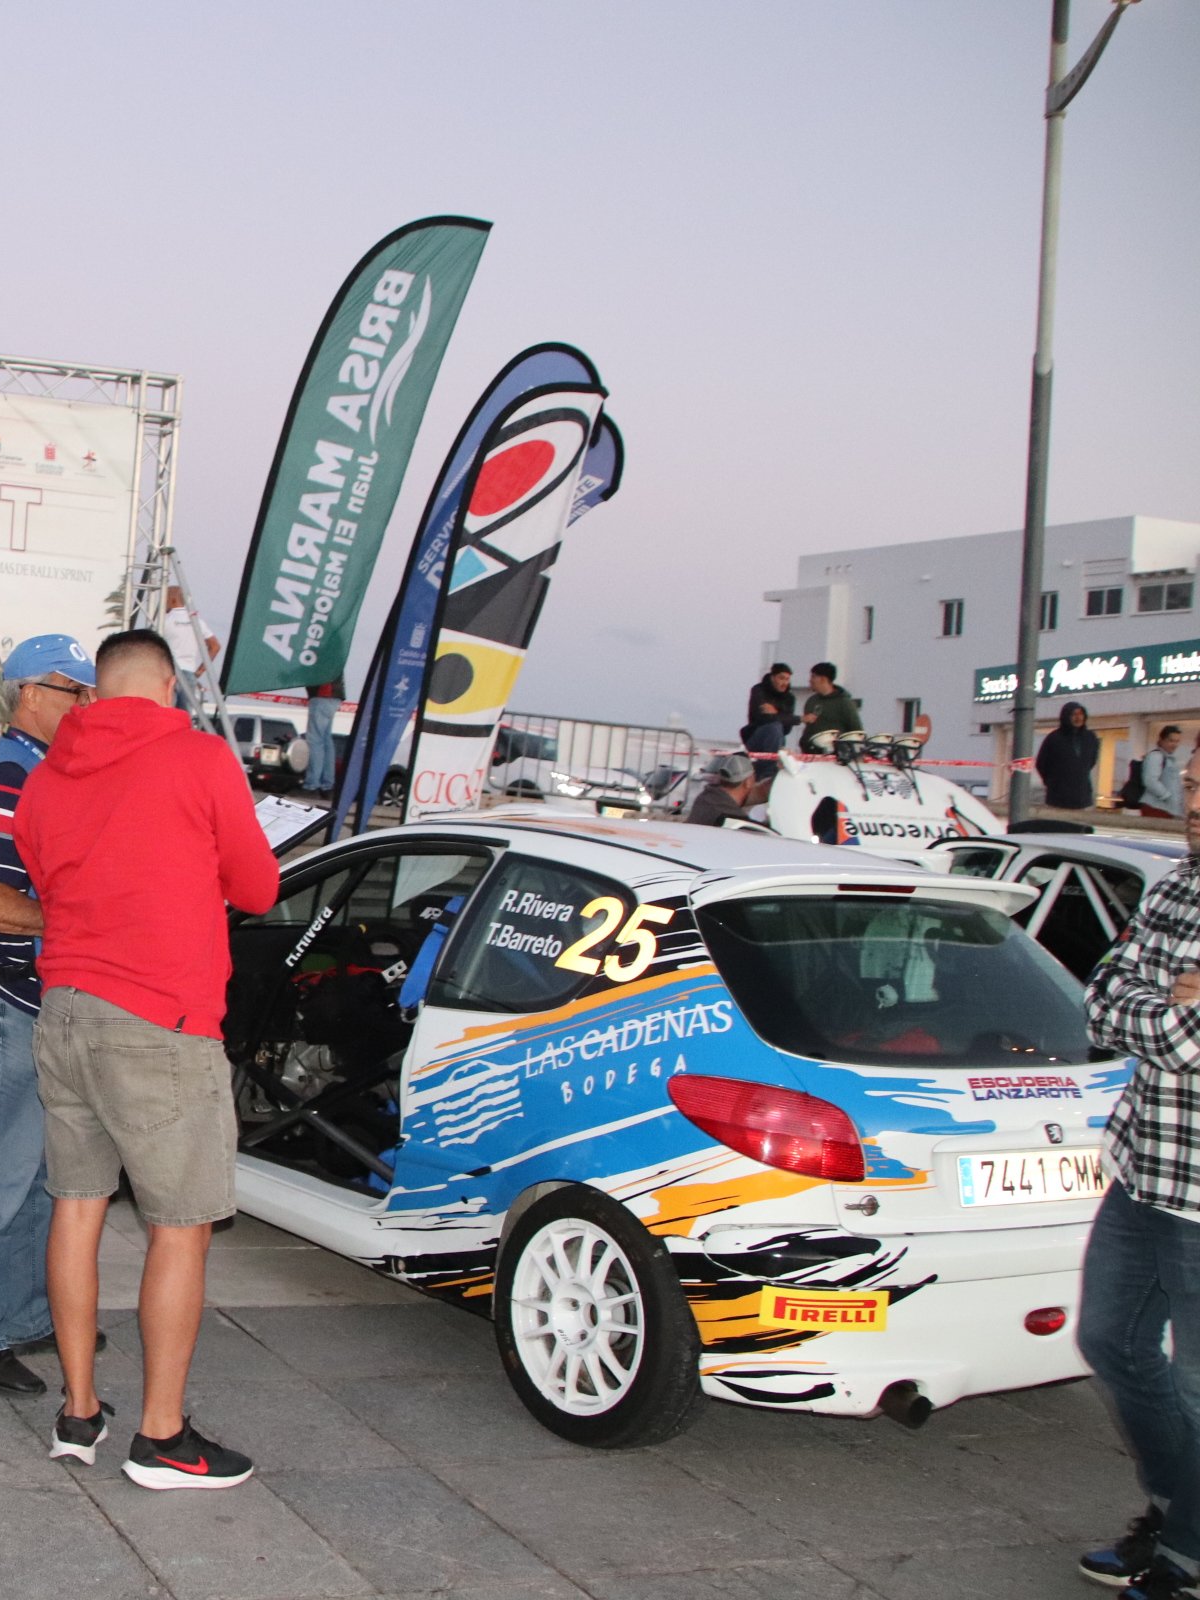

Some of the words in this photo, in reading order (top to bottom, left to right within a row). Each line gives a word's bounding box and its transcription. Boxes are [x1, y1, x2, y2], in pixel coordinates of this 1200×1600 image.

[499, 888, 575, 923] R.Rivera
[488, 922, 564, 959] T.Barreto
[555, 896, 676, 982] 25
[525, 1035, 574, 1080] LAS
[579, 999, 734, 1057] CADENAS
[561, 1054, 687, 1105] BODEGA
[967, 1075, 1078, 1090] ESCUDERIA
[972, 1087, 1083, 1101] LANZAROTE
[980, 1157, 1047, 1197] 7441
[773, 1296, 878, 1325] PIRELLI
